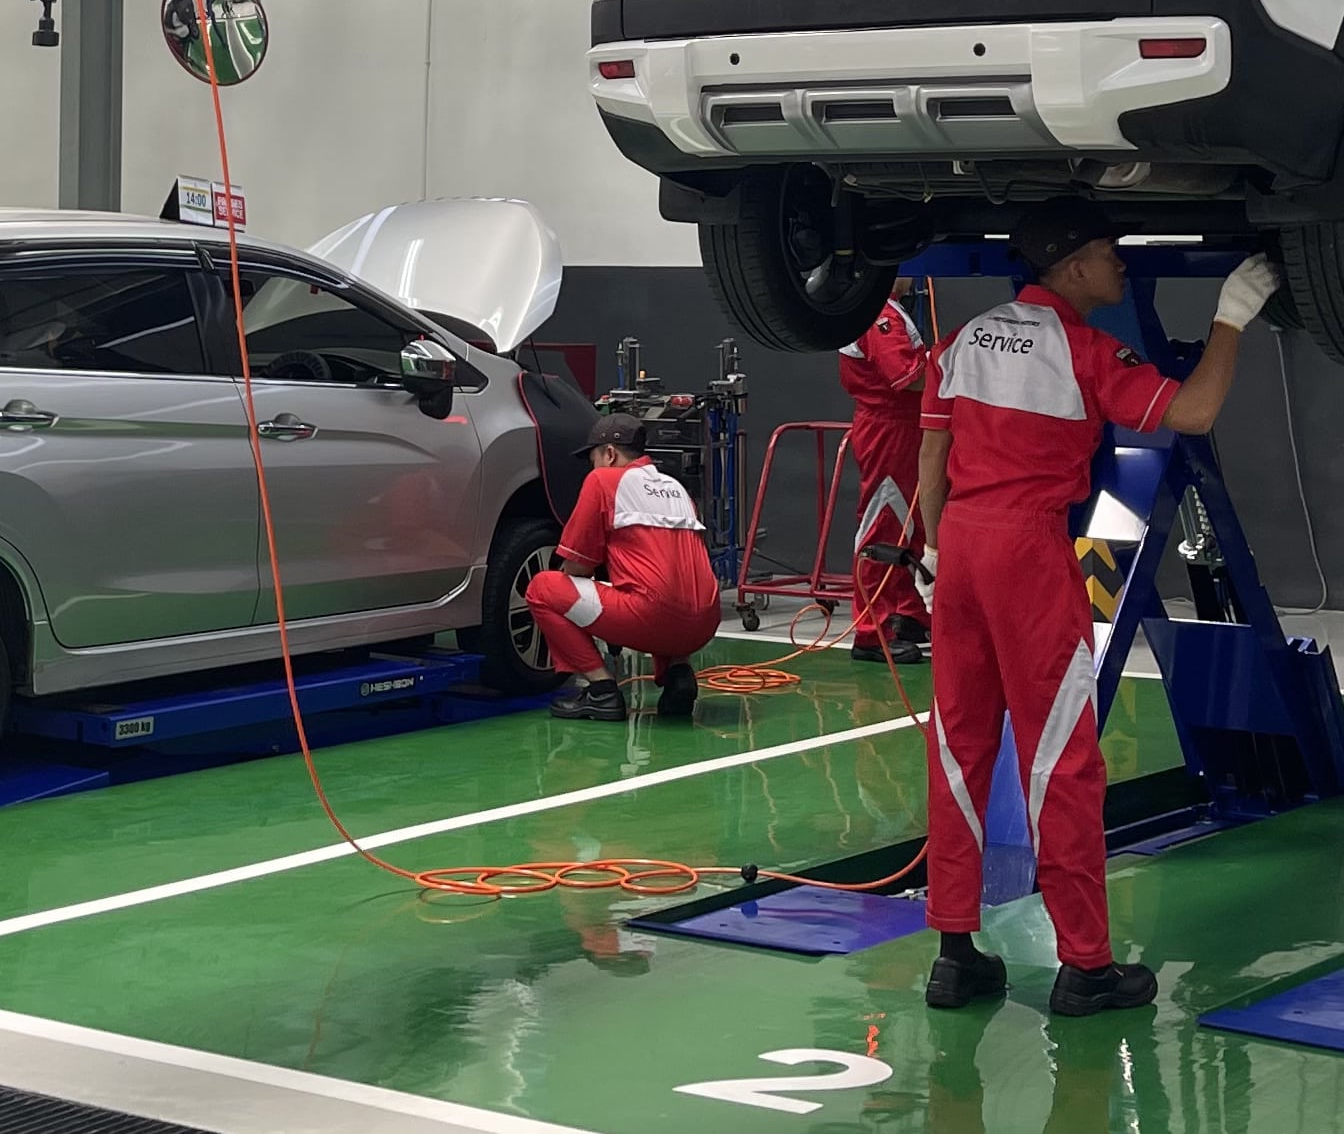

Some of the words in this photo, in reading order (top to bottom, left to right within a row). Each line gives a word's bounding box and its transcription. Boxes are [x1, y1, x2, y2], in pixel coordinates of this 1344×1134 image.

[186, 192, 207, 207] 14:00
[968, 327, 1034, 354] Service
[671, 1048, 894, 1115] 2
